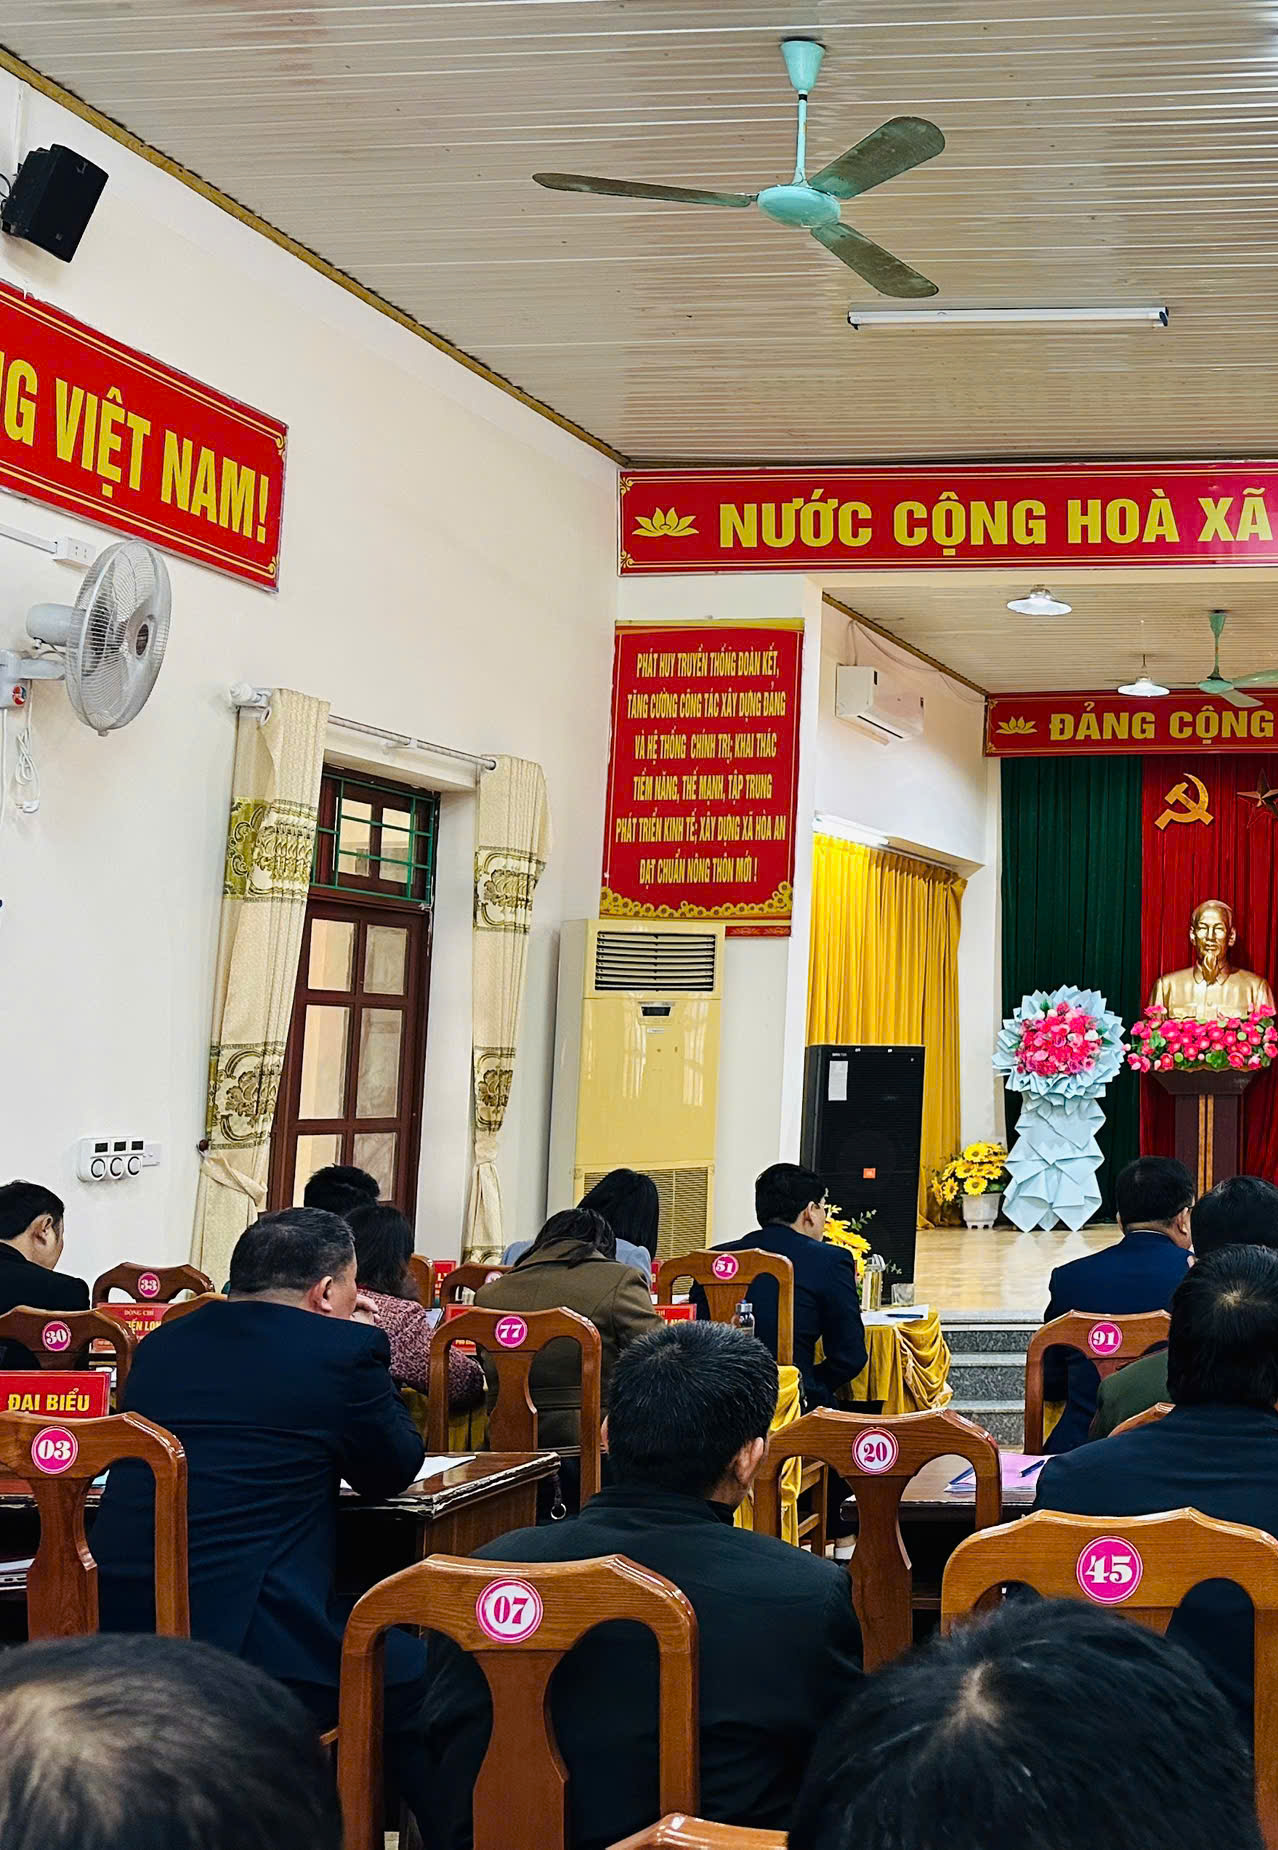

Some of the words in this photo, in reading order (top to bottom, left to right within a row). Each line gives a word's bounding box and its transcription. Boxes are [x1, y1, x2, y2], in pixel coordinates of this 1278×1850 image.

[55, 378, 151, 498] VIỆT
[161, 430, 269, 544] NAM!
[720, 489, 872, 547] NƯỚC
[894, 491, 1046, 556] CỘNG
[1067, 489, 1180, 544] HOÀ
[1198, 487, 1273, 542] XÃ
[637, 649, 658, 677] PHÁT
[659, 652, 676, 676] HUY
[677, 643, 707, 676] TRUYỀN
[710, 643, 736, 676] THỐNG
[738, 647, 762, 676] ĐOÀN
[763, 642, 779, 679] KẾT,
[627, 690, 648, 718] TĂNG
[649, 690, 677, 718] CƯỜNG
[679, 689, 701, 718] CÔNG
[704, 688, 719, 717] TÁC
[721, 688, 738, 717] XÂY
[739, 691, 761, 722] DỰNG
[763, 681, 786, 716] ĐẢNG
[1049, 702, 1155, 740] ĐẢNG
[1170, 706, 1274, 746] CỘNG
[635, 730, 645, 759] VÀ
[647, 730, 658, 764] HỆ
[660, 726, 686, 759] THỐNG
[690, 729, 715, 758] CHÍNH
[718, 735, 733, 764] TRỊ;
[734, 734, 755, 758] KHAI
[757, 729, 776, 757] THÁC
[655, 770, 679, 803] NĂNG,
[682, 767, 697, 800] THẾ
[699, 775, 725, 805] MẠNH,
[728, 770, 744, 805] TẬP
[745, 774, 772, 799] TRUNG
[616, 813, 636, 842] PHÁT
[638, 807, 662, 842] TRIỂN
[664, 817, 683, 841] KINH
[699, 811, 716, 841] XÂY
[717, 815, 740, 846] DỰNG
[742, 811, 754, 840] XÃ
[755, 810, 772, 840] HÒA
[773, 816, 786, 840] AN
[640, 858, 655, 889] ĐẠT
[657, 849, 685, 883] CHUẨN
[687, 854, 710, 883] NÔNG
[713, 853, 735, 882] THÔN
[715, 1260, 734, 1274] 51
[141, 1279, 157, 1291] 33
[46, 1330, 67, 1344] 30
[500, 1325, 522, 1339] 77
[1092, 1331, 1118, 1346] 91
[46, 1388, 90, 1412] BIỂU
[38, 1439, 70, 1460] 03
[863, 1443, 888, 1462] 20
[1084, 1556, 1134, 1584] 45
[493, 1596, 528, 1624] 07
